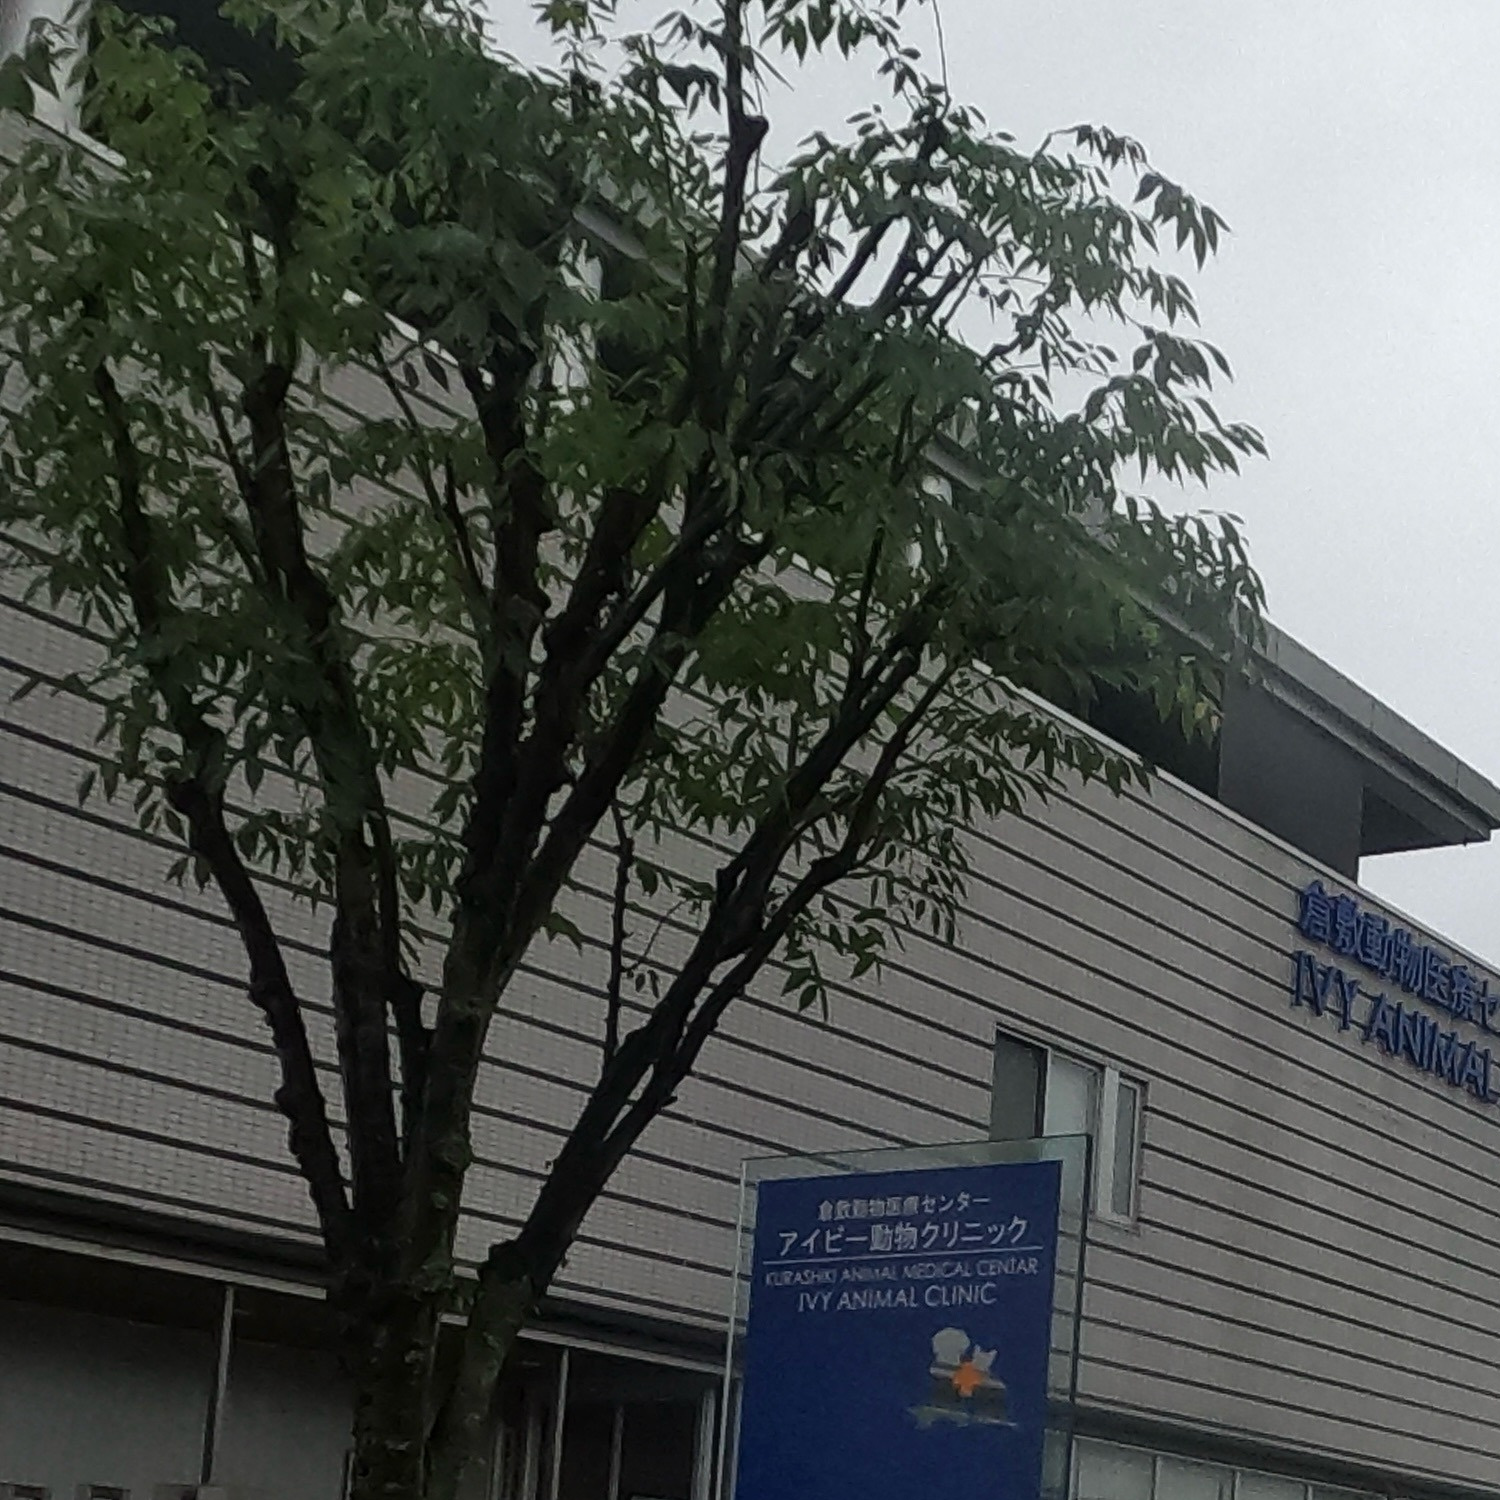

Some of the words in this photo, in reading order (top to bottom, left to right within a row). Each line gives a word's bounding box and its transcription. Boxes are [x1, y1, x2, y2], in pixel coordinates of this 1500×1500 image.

[1291, 951, 1361, 1031] IVY
[1362, 994, 1500, 1105] ANIMAL
[779, 1215, 1028, 1256] アイビー動物クリニック
[840, 1265, 897, 1282] ANIMAL
[903, 1261, 972, 1280] MEDICAL
[798, 1292, 833, 1312] IVY
[837, 1287, 919, 1310] ANIMAL
[924, 1282, 997, 1306] CLINIC
